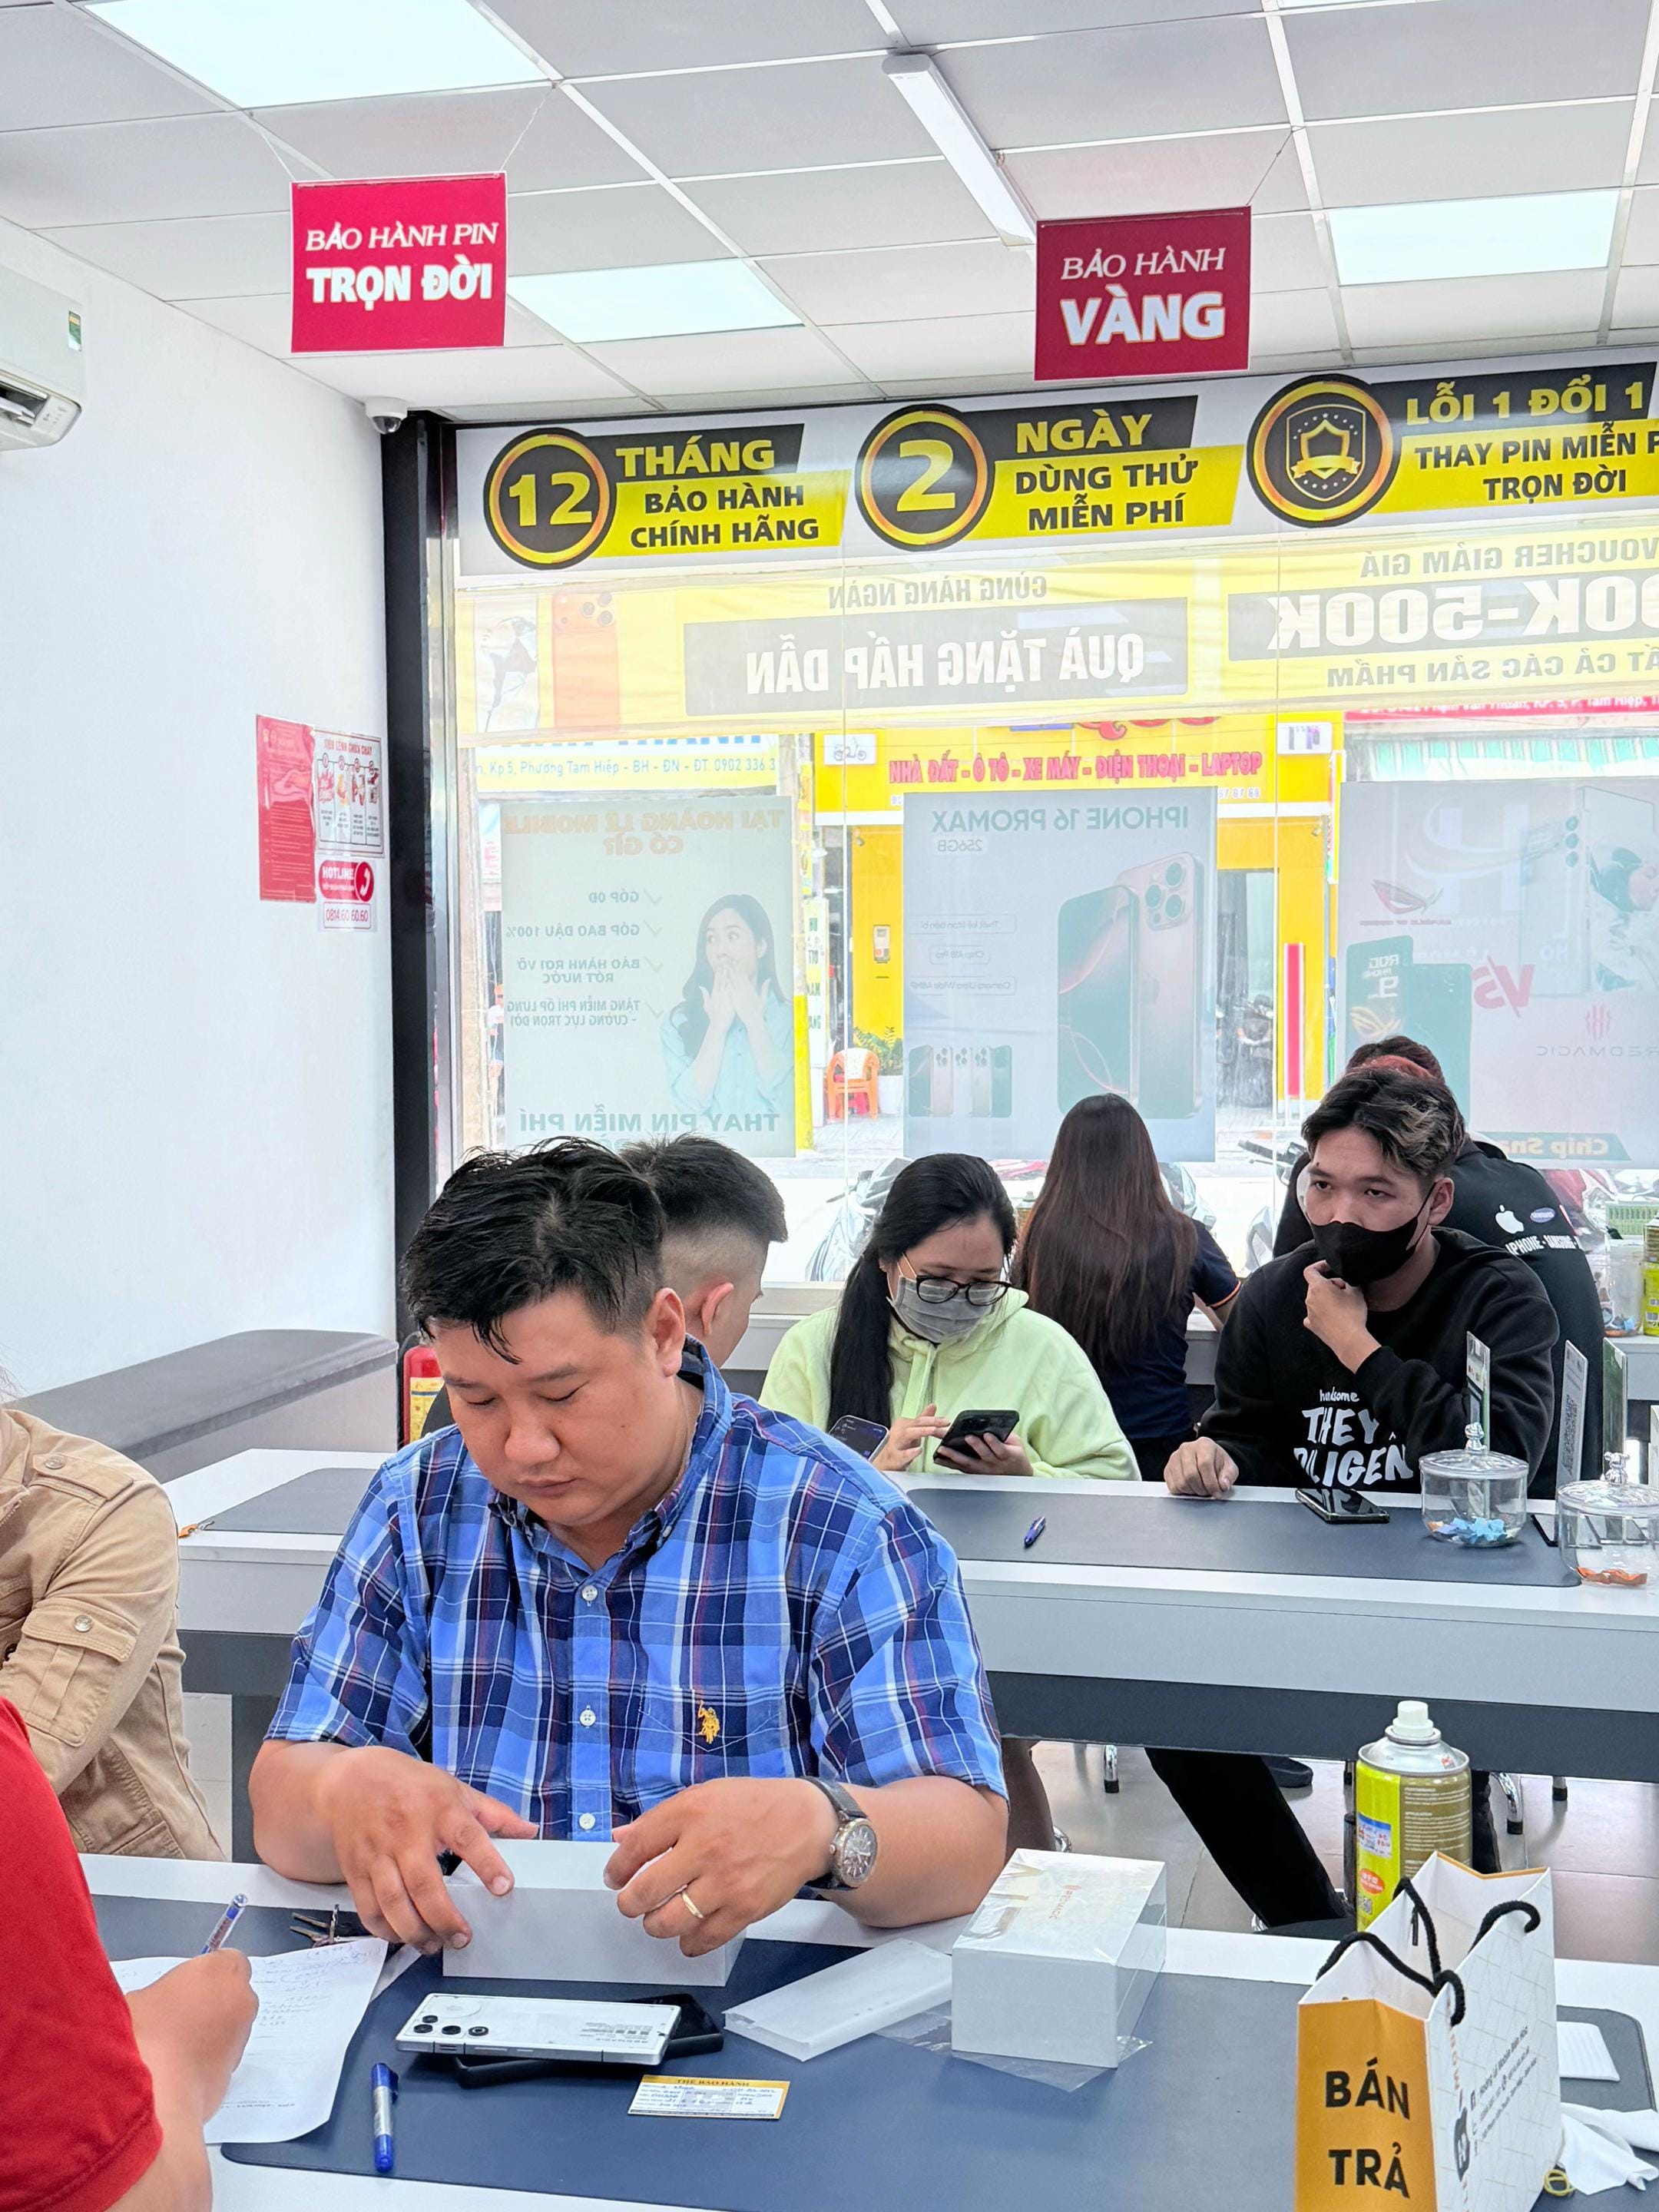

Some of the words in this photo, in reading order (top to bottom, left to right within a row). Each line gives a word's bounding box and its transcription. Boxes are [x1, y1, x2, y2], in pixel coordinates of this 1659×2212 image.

[306, 222, 361, 251] BẢO
[369, 221, 447, 250] HÀNH
[453, 222, 499, 245] PIN
[306, 264, 411, 310] TRỌN
[421, 254, 492, 301] ĐỜI
[1061, 248, 1126, 280] BẢO
[1134, 245, 1227, 276] HÀNH
[1060, 283, 1225, 346] VÀNG
[1407, 382, 1475, 426] LỖI
[1493, 392, 1510, 419] 1
[1528, 374, 1606, 416] ĐỔI
[1625, 382, 1643, 409] 1
[1016, 409, 1151, 454] NGÀY
[1415, 442, 1493, 469] THAY
[1502, 438, 1550, 464] PIN
[1562, 421, 1636, 459] MIỄN
[616, 435, 774, 478] THÁNG
[897, 439, 955, 512] 2
[1016, 464, 1111, 494] DÙNG
[1123, 453, 1198, 487] THỬ
[508, 471, 592, 527] 12
[645, 485, 707, 514] BẢO
[719, 482, 803, 510] HÀNH
[1483, 475, 1562, 504] TRỌN
[1573, 464, 1626, 495] ĐỜI
[631, 520, 720, 548] CHÍNH
[732, 515, 819, 543] HÃNG
[1028, 492, 1113, 531] MIỄN
[1126, 493, 1186, 525] PHÍ
[567, 760, 590, 773] Tam
[633, 760, 649, 773] BH
[714, 757, 741, 772] 0902
[746, 757, 765, 771] 336
[889, 753, 923, 783] NHÀ
[928, 750, 959, 783] ĐẤT
[973, 753, 985, 782] Ô
[988, 752, 1009, 781] TÔ
[1023, 757, 1043, 780] XE
[1047, 750, 1081, 780] MÁY
[1095, 749, 1133, 784] ĐIỆN
[1137, 753, 1185, 783] THOẠI
[1201, 752, 1263, 776] LAPTOP
[322, 866, 354, 882] HOTLINE
[1301, 1406, 1380, 1446] THEY
[1325, 2057, 1410, 2121] BÁN
[1328, 2141, 1410, 2200] TRẢ
